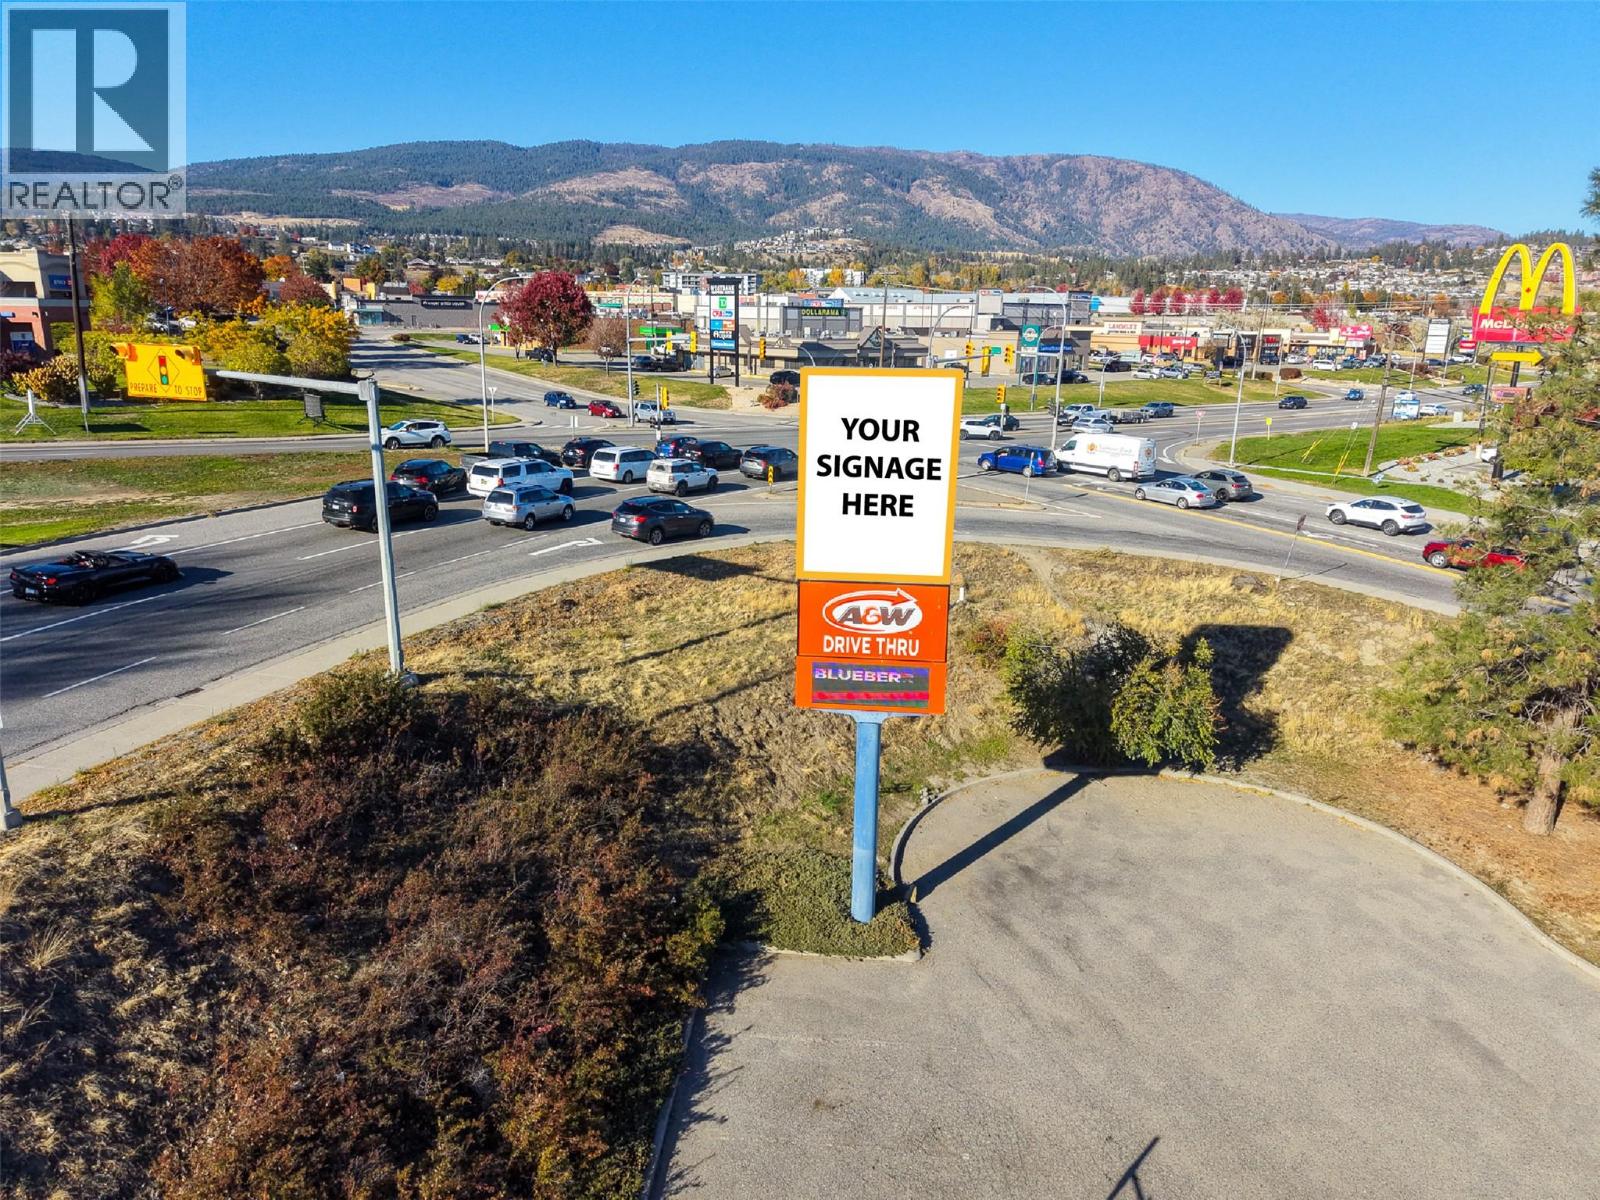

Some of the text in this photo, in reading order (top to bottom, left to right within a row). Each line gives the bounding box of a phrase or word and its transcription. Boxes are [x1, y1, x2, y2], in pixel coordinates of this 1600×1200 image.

[801, 308, 839, 316] DOLLARAMA
[130, 381, 202, 396] PREPARE TO STOP
[841, 417, 920, 442] YOUR
[816, 454, 942, 480] SIGNAGE
[842, 493, 914, 517] HERE
[838, 604, 915, 626] A&W
[823, 635, 920, 656] DRIVE THRU
